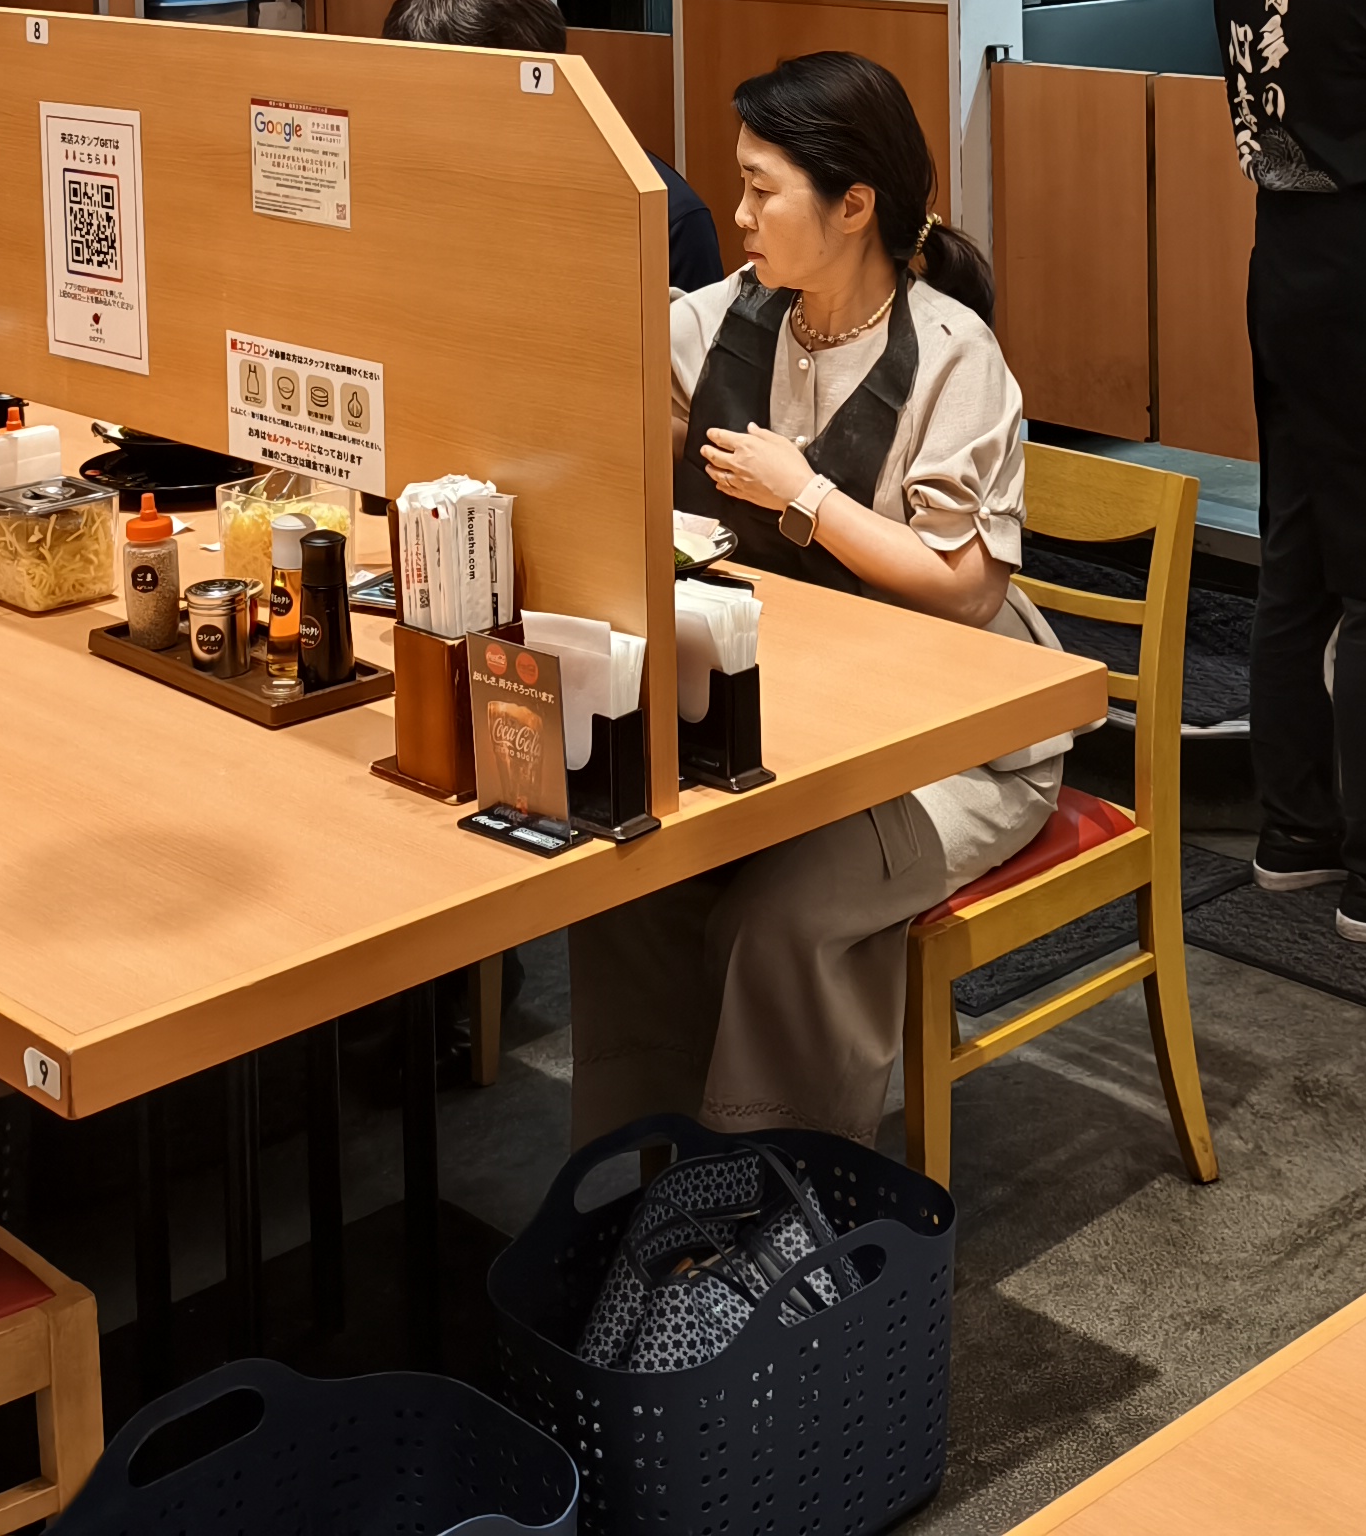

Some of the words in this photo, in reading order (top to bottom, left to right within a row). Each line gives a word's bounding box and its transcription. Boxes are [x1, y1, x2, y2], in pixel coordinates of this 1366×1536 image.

[34, 21, 41, 40] 8
[532, 67, 541, 89] 9
[255, 112, 302, 142] Google
[197, 632, 222, 642] コショウ
[493, 717, 541, 756] Coca-Cola
[40, 1060, 48, 1086] 9
